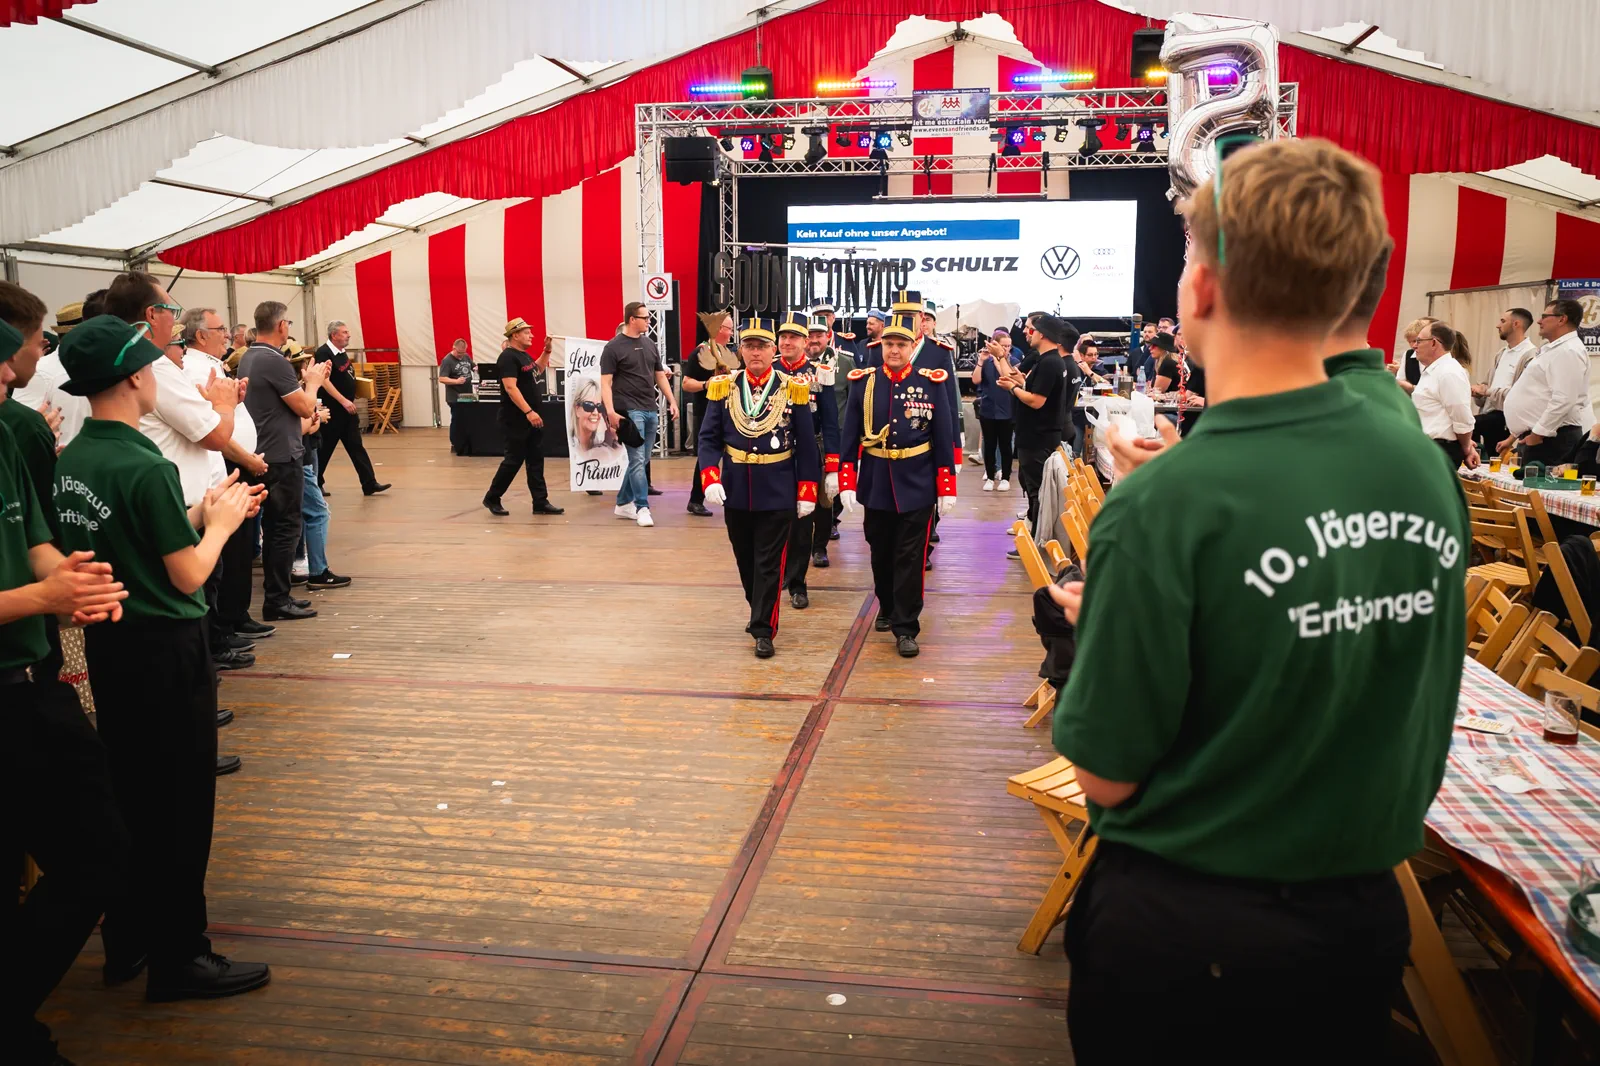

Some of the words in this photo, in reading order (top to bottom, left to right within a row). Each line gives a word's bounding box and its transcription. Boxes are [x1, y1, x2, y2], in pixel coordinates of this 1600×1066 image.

[796, 230, 817, 238] Kein
[820, 229, 843, 238] Kauf
[844, 229, 869, 237] ohne
[901, 228, 947, 238] Angebot!
[921, 256, 1019, 272] SCHULTZ
[567, 347, 596, 378] Lebe
[576, 458, 622, 487] Traum
[61, 475, 112, 519] Jägerzug
[1244, 547, 1308, 597] 10.
[1305, 509, 1461, 569] Jägerzug
